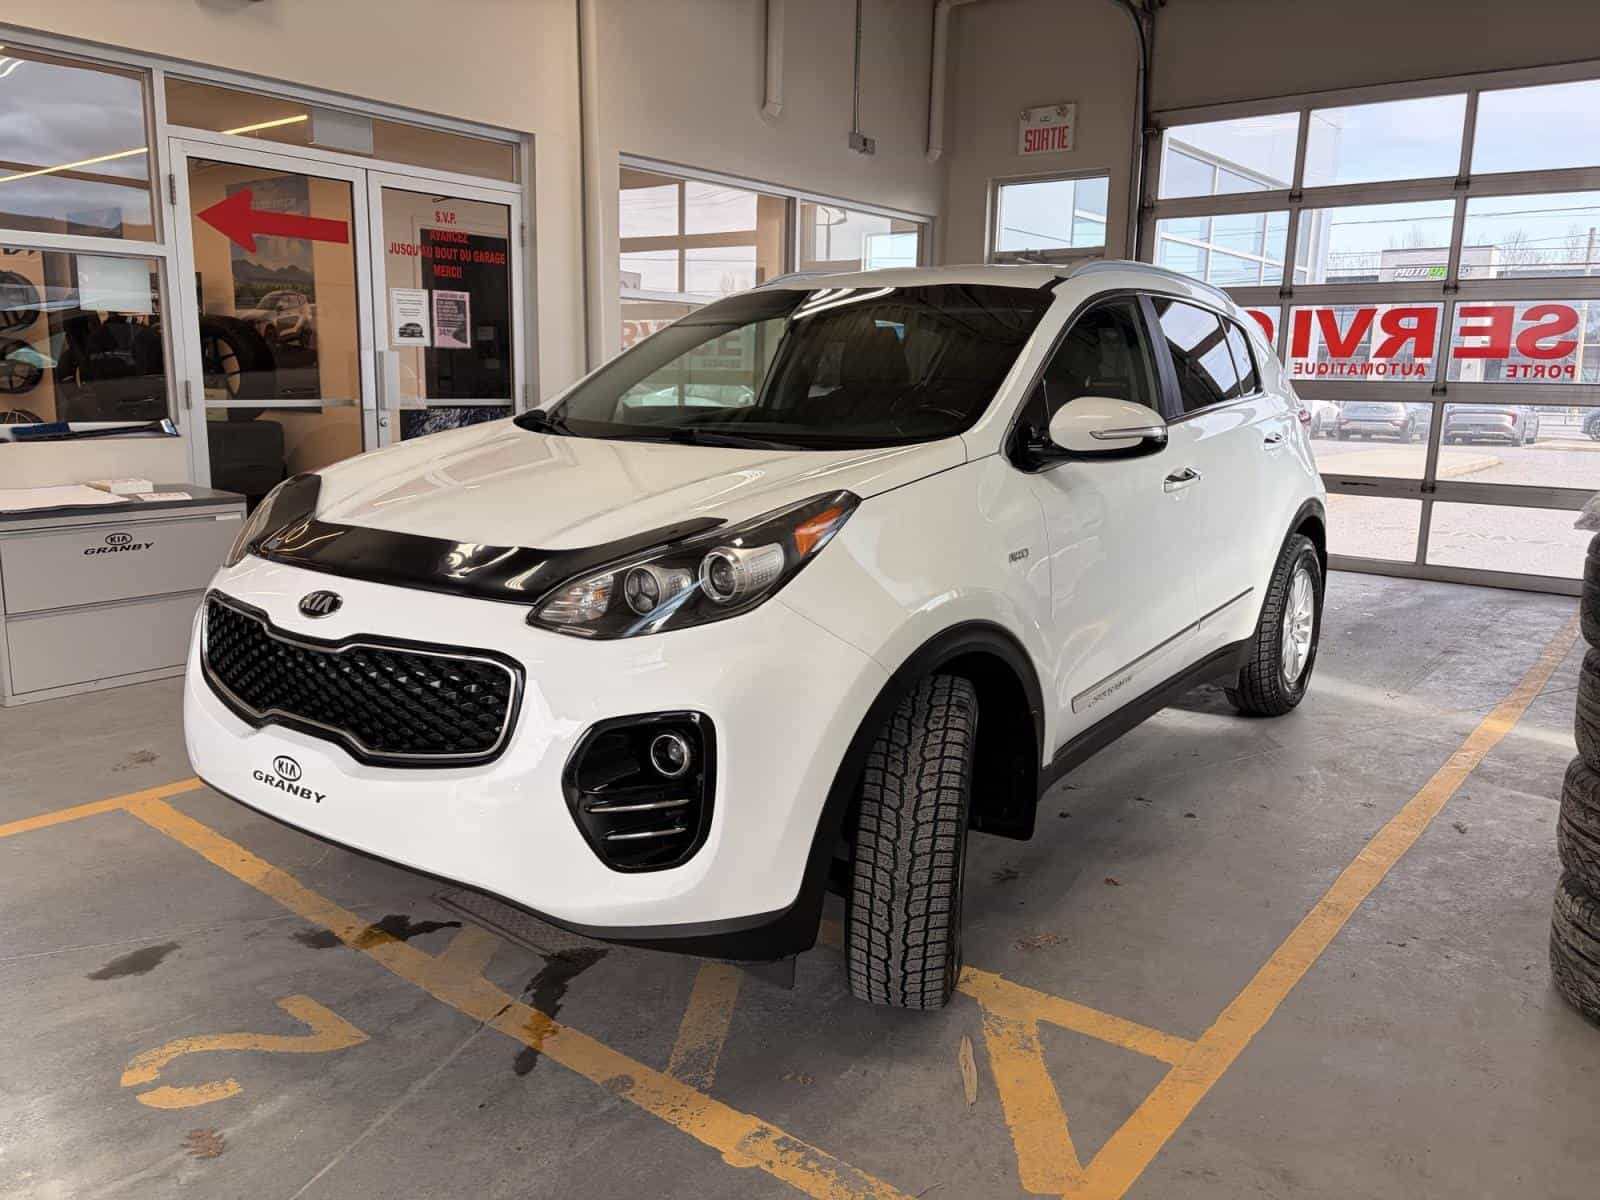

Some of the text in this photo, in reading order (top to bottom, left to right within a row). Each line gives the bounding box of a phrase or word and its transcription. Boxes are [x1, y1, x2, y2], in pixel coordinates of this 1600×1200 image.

[1024, 126, 1069, 152] SORTIE
[435, 211, 456, 224] S.V.P.
[435, 246, 458, 261] BOUT
[460, 248, 472, 263] DU
[474, 250, 505, 264] GARAGE
[84, 542, 154, 555] GRANBY
[301, 594, 331, 612] KIA
[252, 769, 327, 804] GRANBY
